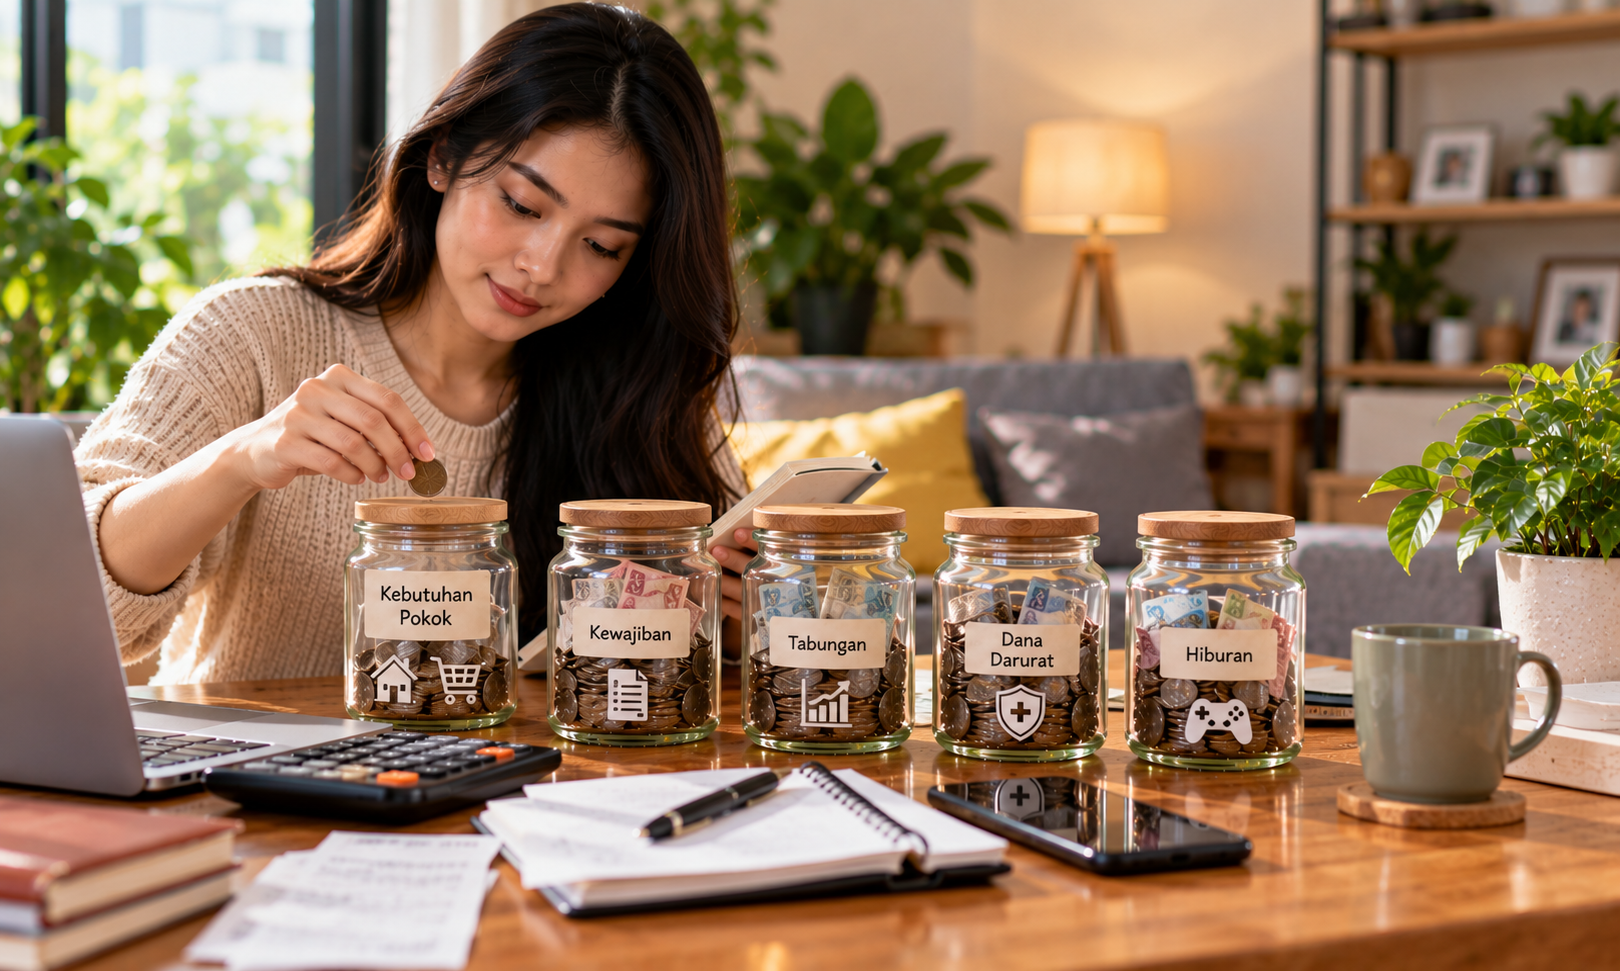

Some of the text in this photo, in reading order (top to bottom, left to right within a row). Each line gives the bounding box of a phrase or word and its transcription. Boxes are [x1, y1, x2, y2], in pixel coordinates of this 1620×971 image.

[380, 585, 473, 603] Kebutuhan
[400, 609, 453, 626] Pokok
[590, 624, 672, 646] Kewajiban
[1001, 631, 1043, 648] Dana
[787, 634, 867, 657] Tabungan
[1186, 645, 1253, 663] Hiburan
[990, 652, 1055, 669] Darurat
